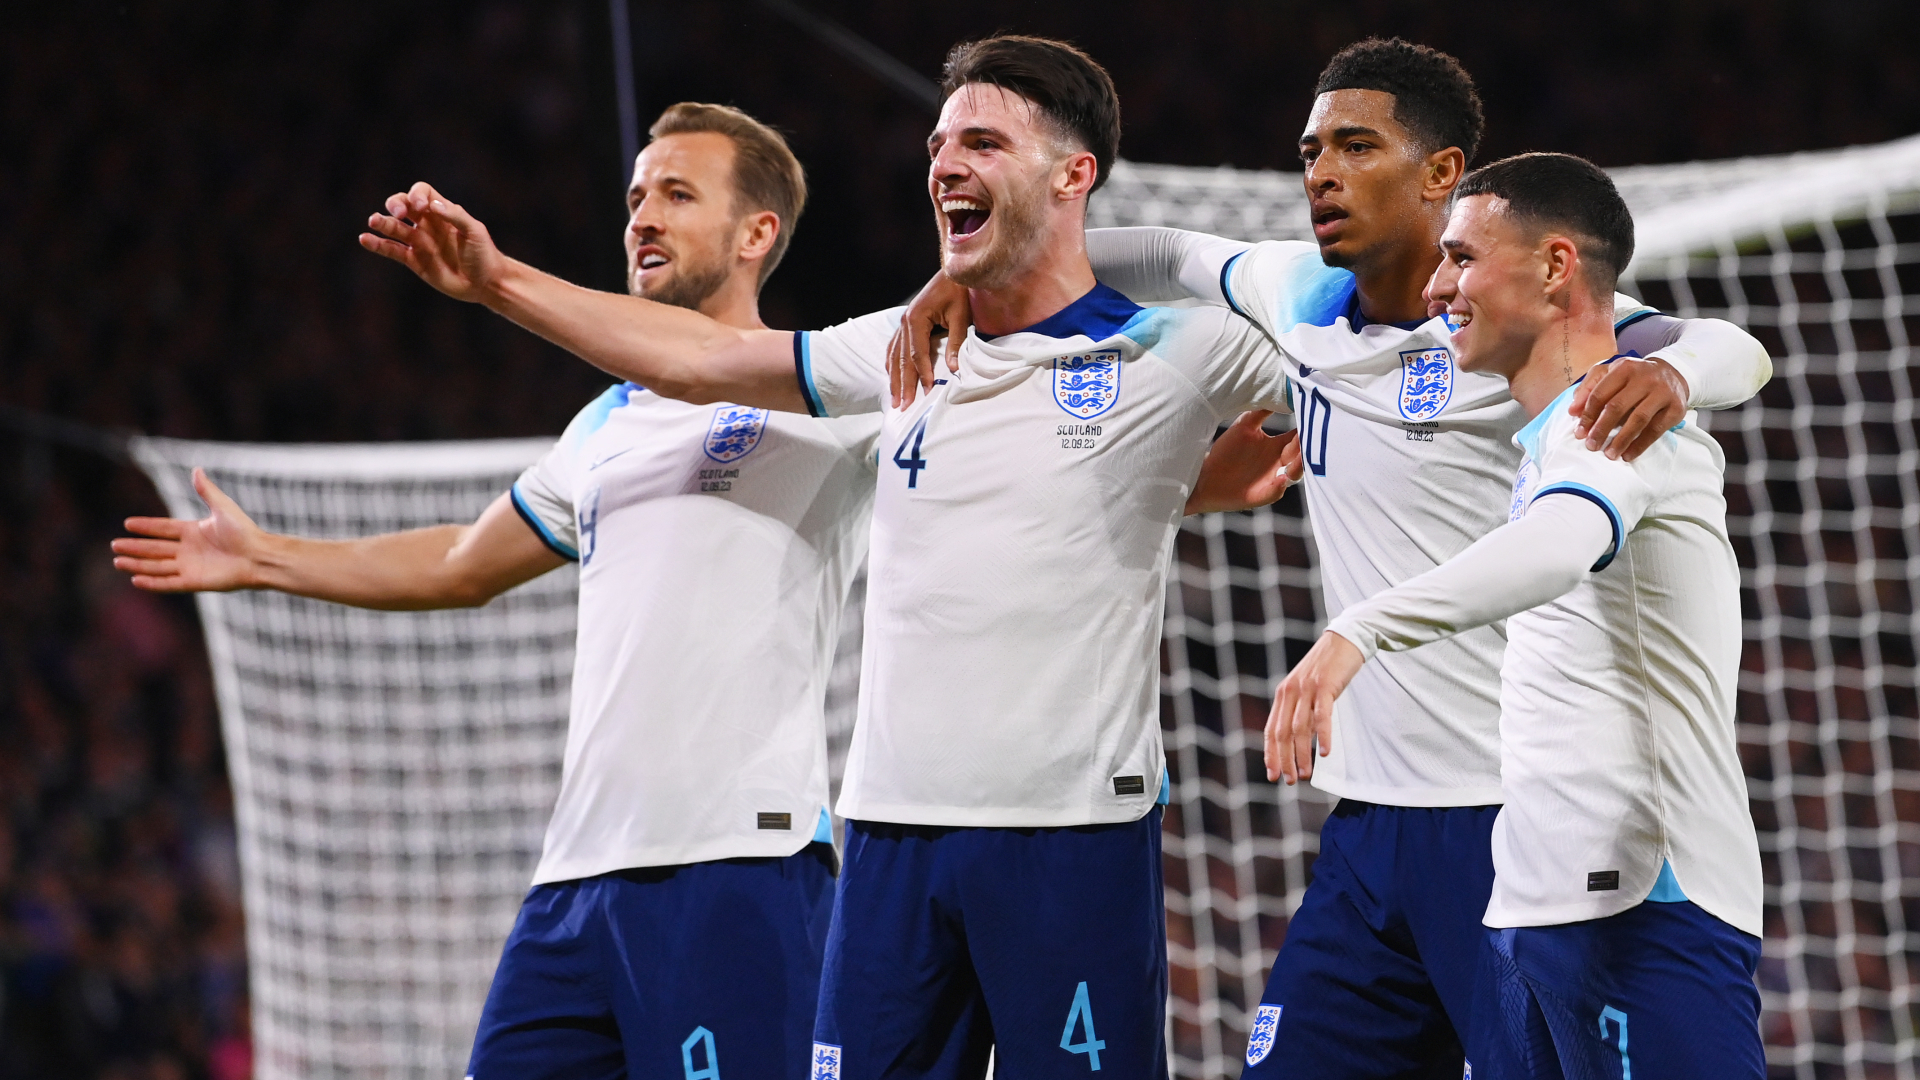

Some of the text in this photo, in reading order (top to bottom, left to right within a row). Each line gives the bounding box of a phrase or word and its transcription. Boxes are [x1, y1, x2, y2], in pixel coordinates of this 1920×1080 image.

[892, 404, 934, 489] 4
[1056, 424, 1102, 436] SCOTLAND
[1061, 438, 1095, 449] 12.09.23
[1296, 382, 1331, 477] 10
[1406, 429, 1434, 442] 12.09.23
[698, 468, 740, 480] SCOTLAND
[579, 484, 601, 567] 9
[1059, 981, 1106, 1071] 4
